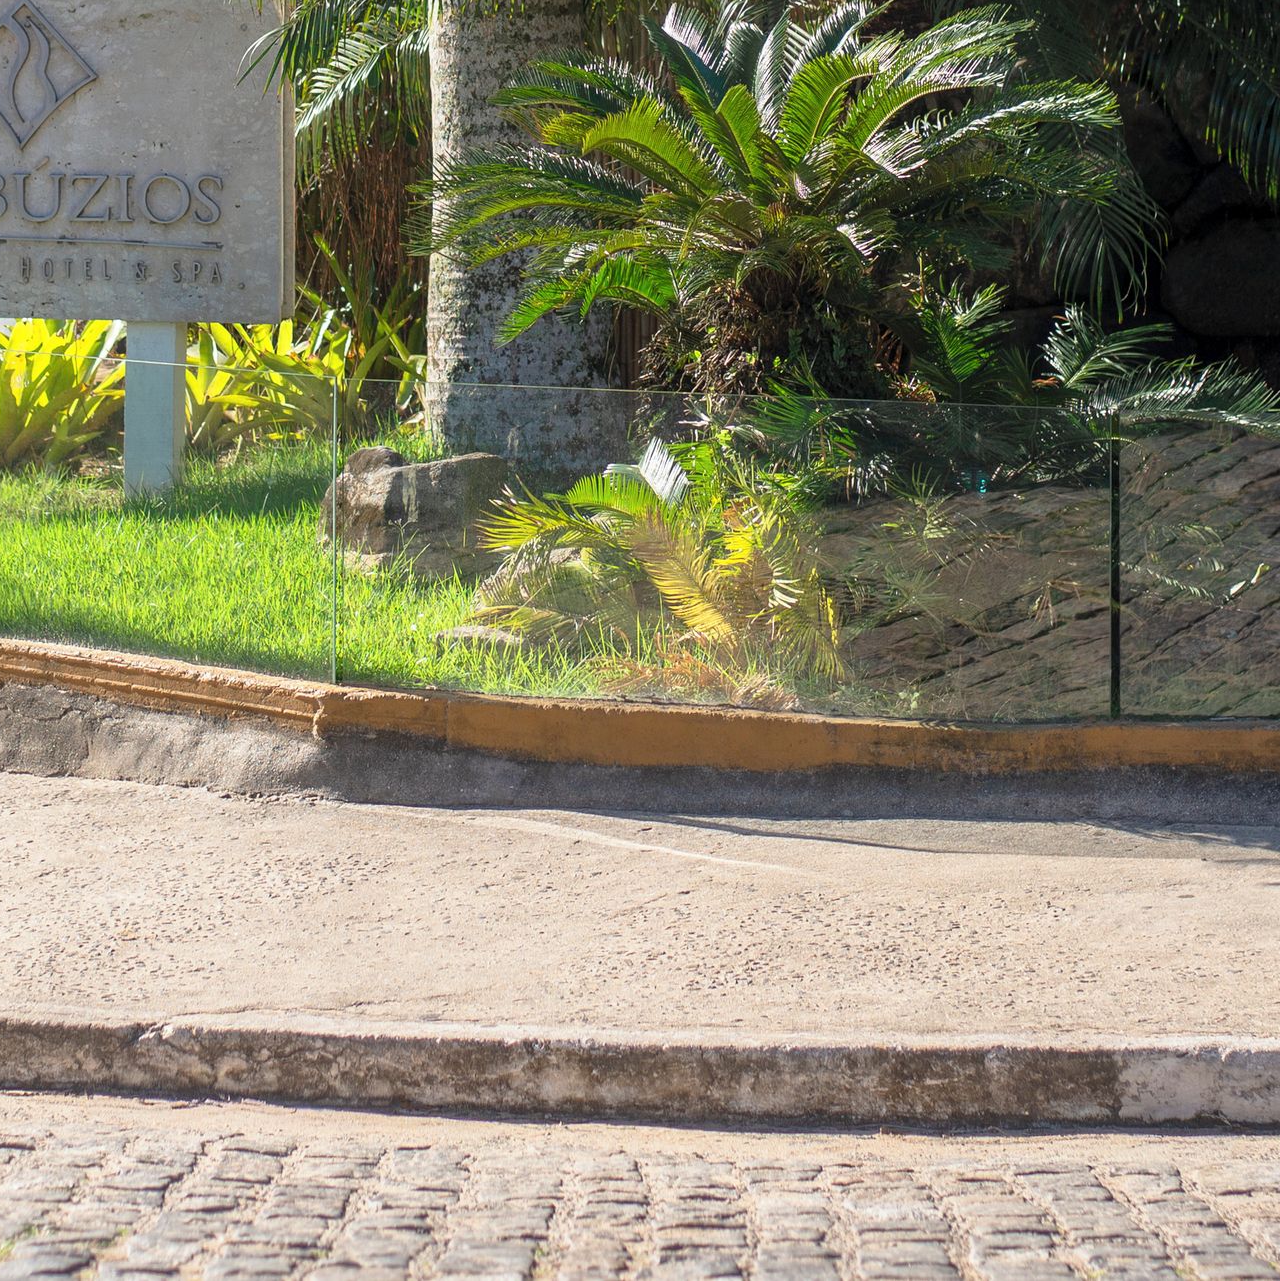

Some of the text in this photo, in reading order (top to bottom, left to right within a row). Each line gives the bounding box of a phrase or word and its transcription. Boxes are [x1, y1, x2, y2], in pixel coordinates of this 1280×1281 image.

[21, 256, 112, 282] HOTEL
[135, 260, 148, 282] &
[172, 261, 223, 283] SPA
